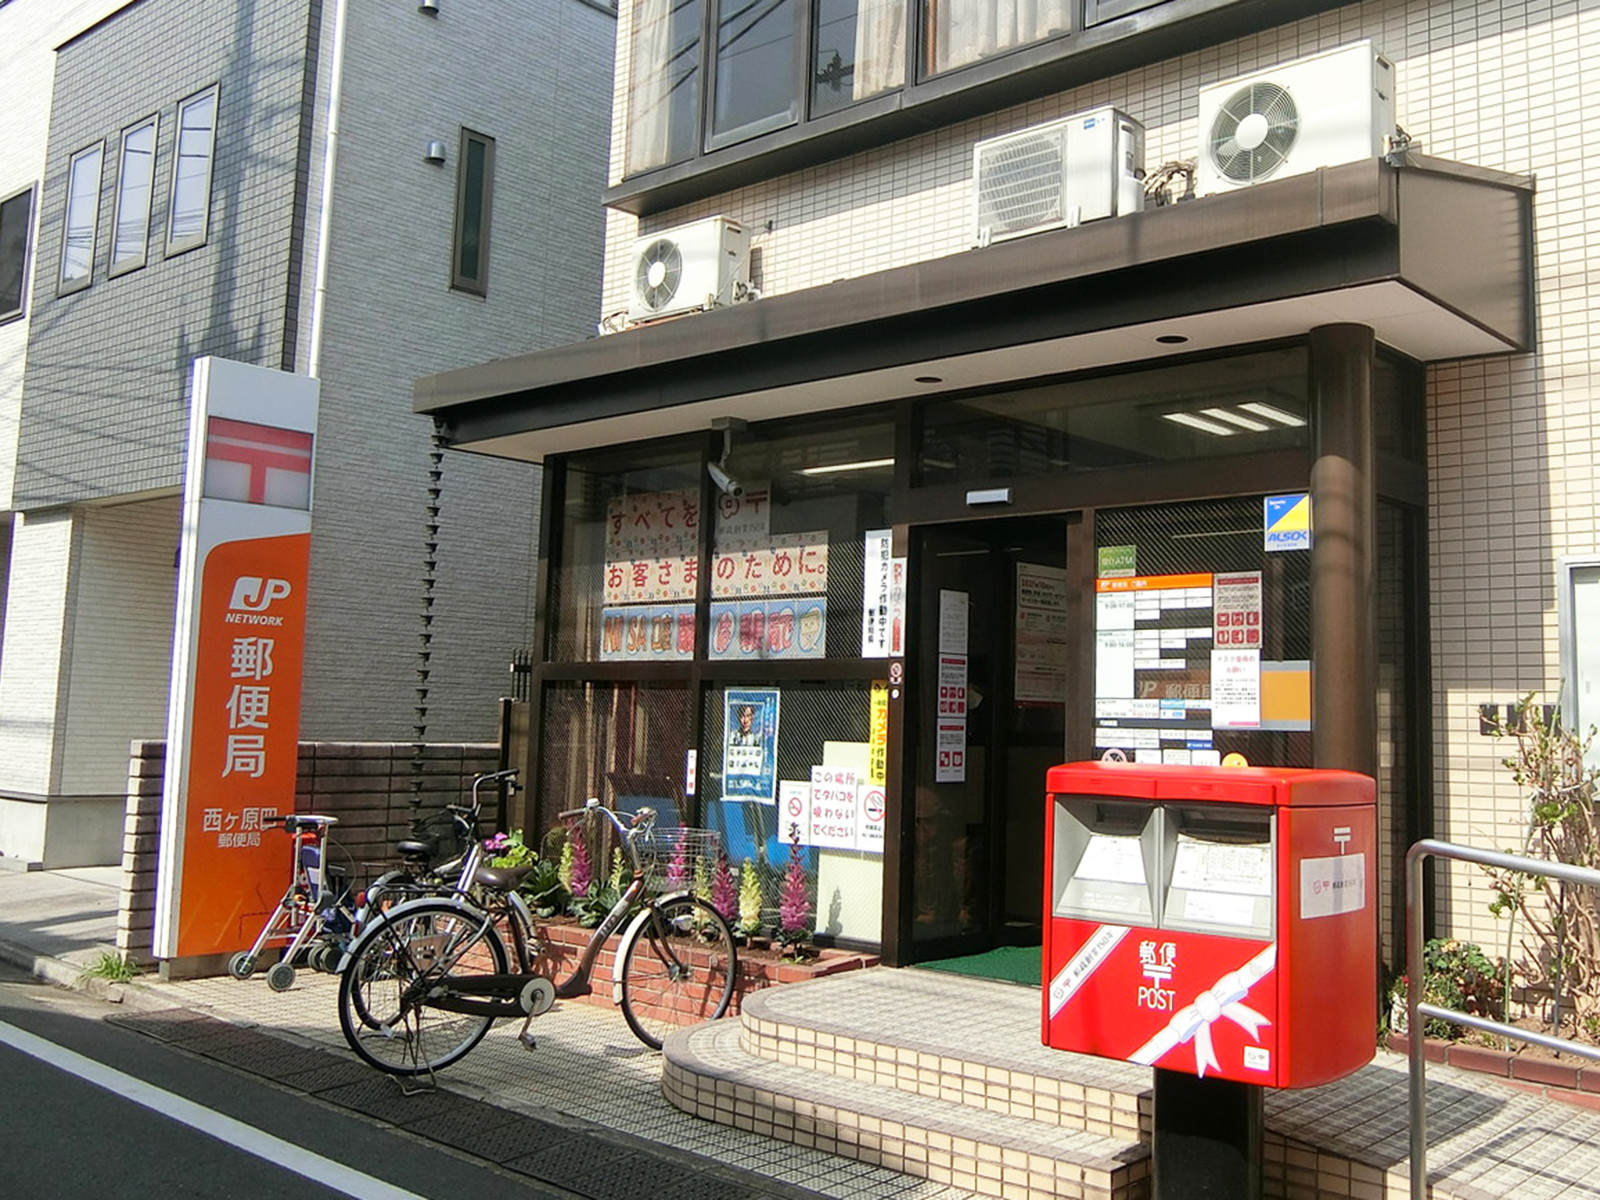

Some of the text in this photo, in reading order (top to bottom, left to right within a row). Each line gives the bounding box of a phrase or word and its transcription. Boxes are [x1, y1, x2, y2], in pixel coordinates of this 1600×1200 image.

[611, 504, 698, 535] すべてを
[1268, 531, 1307, 542] ALSOK
[229, 576, 291, 611] JP
[225, 613, 284, 626] NETWORK
[222, 637, 274, 778] 郵便局
[814, 772, 855, 785] この場所
[813, 789, 854, 803] でタバコを
[813, 824, 854, 838] でください
[218, 832, 261, 848] 郵便局
[1139, 940, 1177, 968] 郵便
[1138, 986, 1176, 1011] POST
